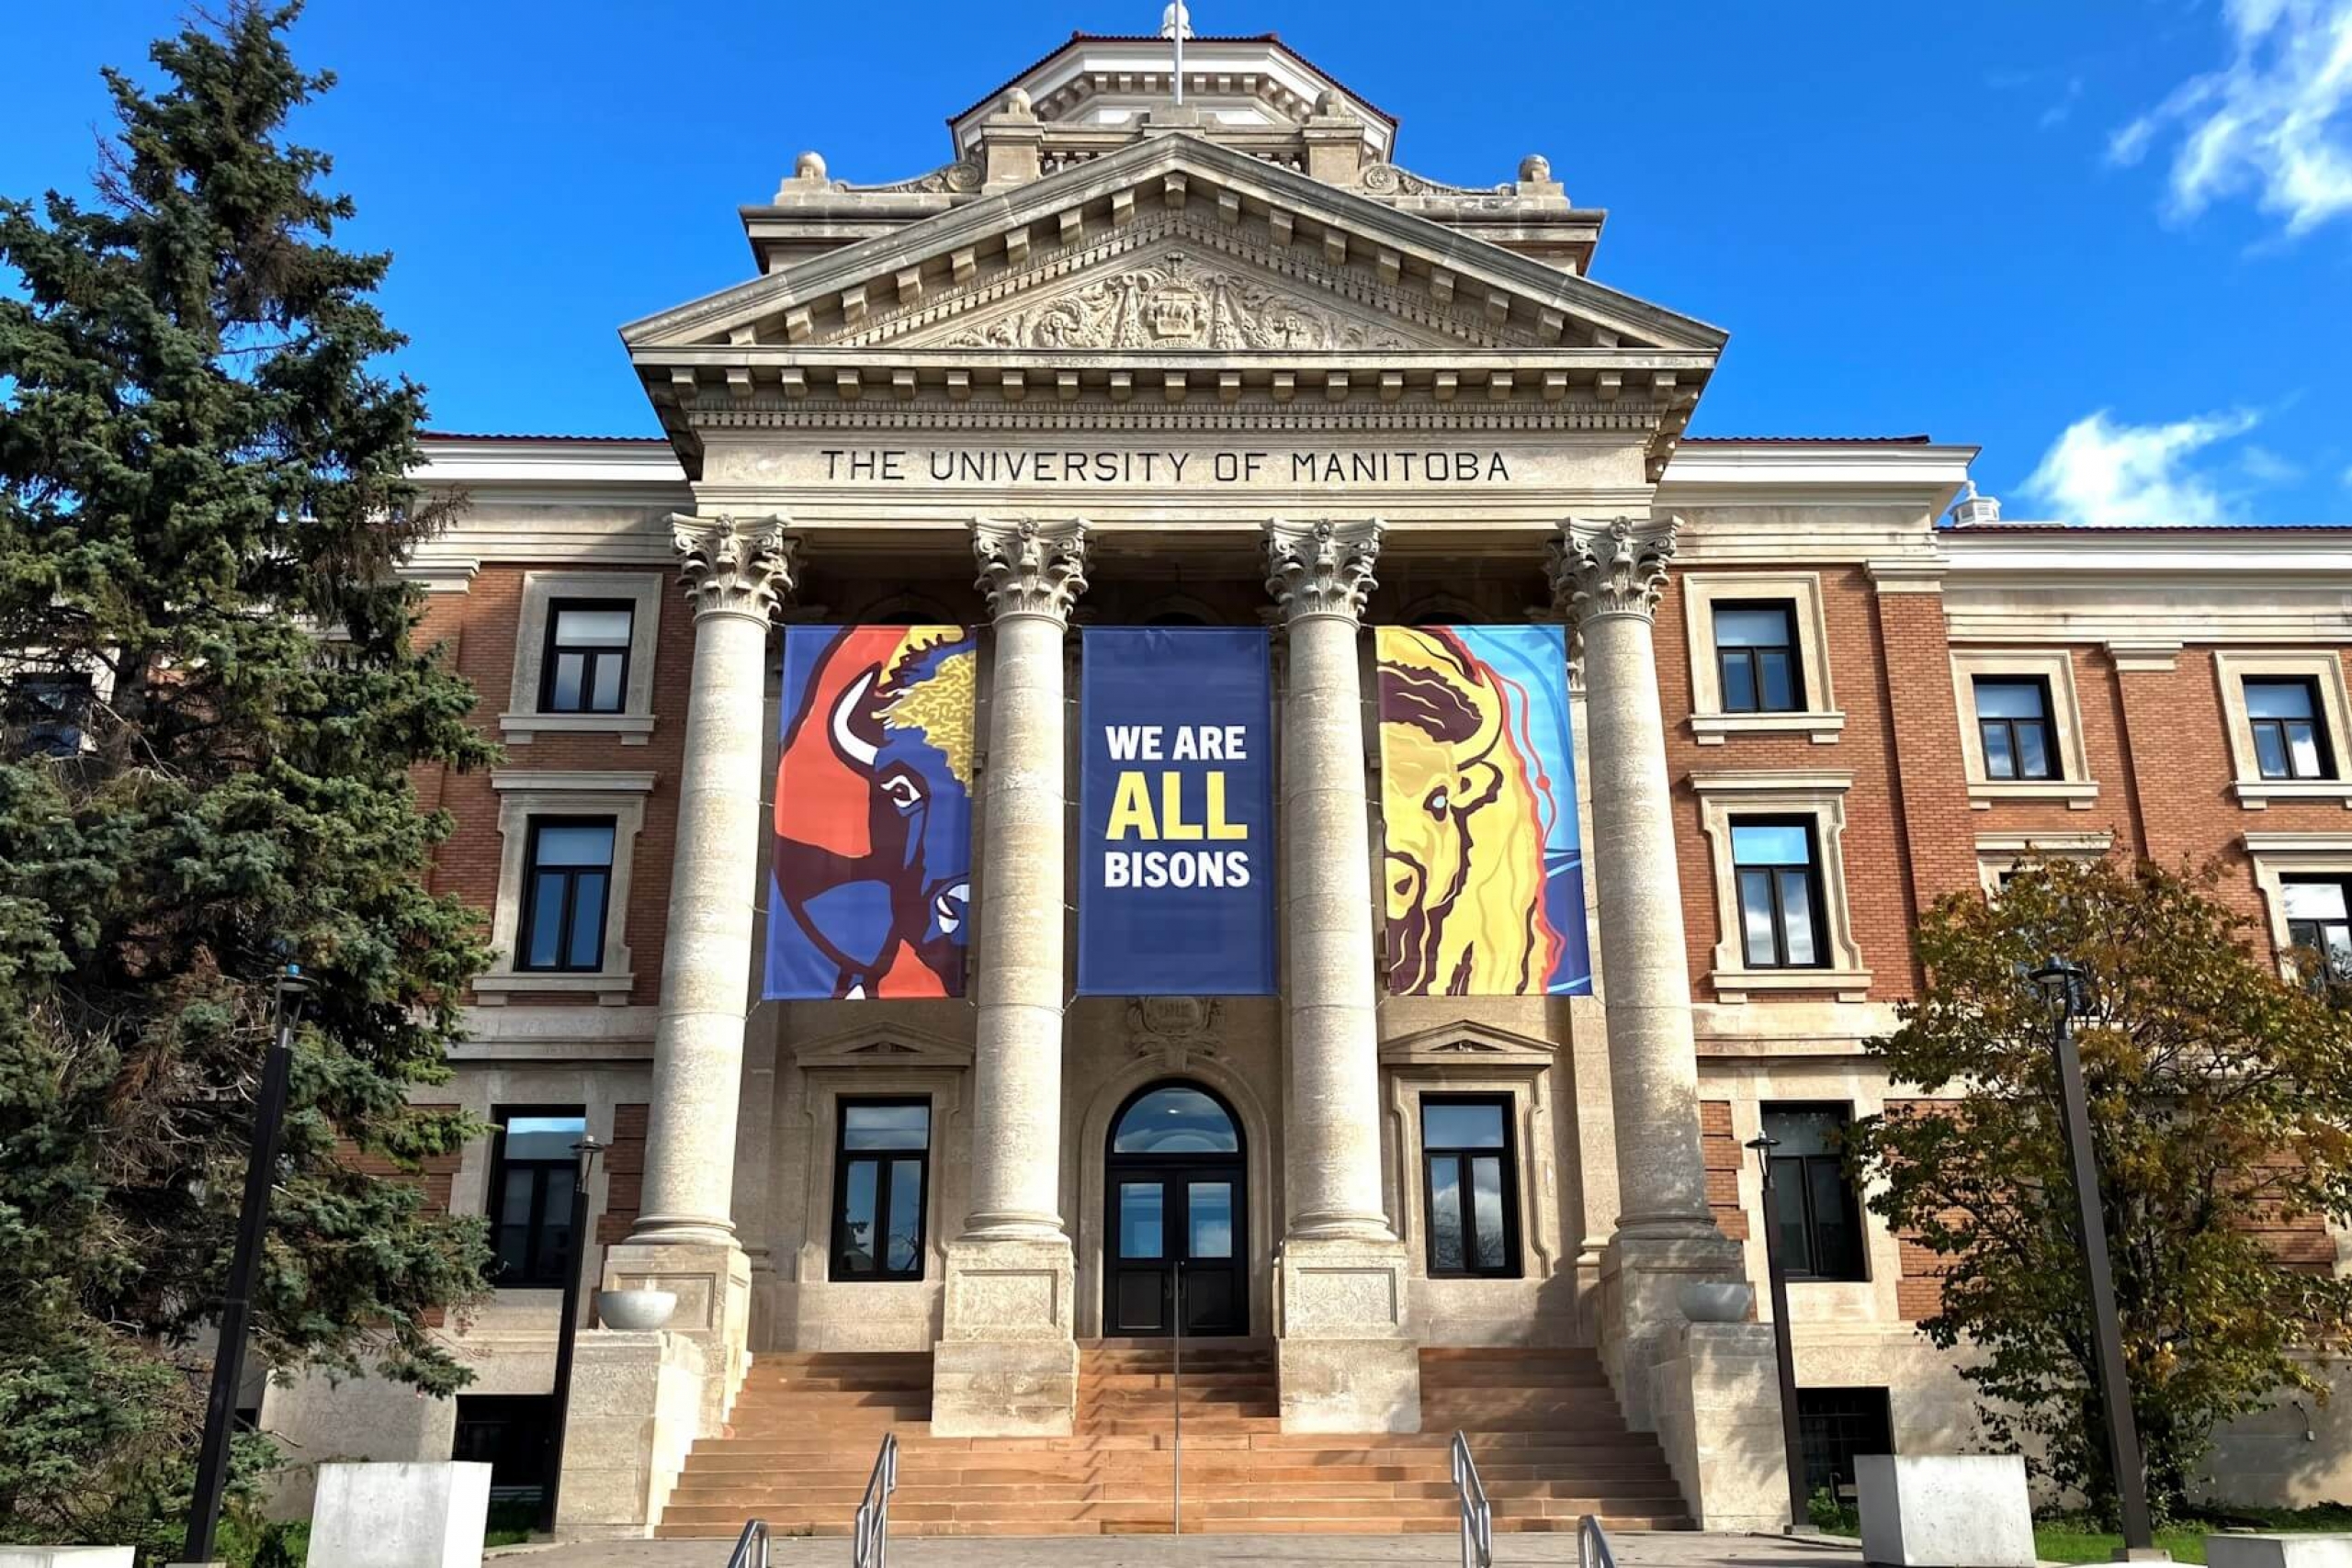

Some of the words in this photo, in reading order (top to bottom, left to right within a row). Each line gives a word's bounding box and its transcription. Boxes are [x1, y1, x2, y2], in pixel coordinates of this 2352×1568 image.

[820, 450, 907, 480] THE
[931, 451, 1190, 481] UNIVERSITY
[1215, 453, 1268, 481] OF
[1292, 452, 1510, 482] MANITOBA
[1104, 725, 1163, 761] WE
[1172, 725, 1247, 761] ARE
[1105, 771, 1248, 840] ALL
[1104, 851, 1250, 888] BISONS
